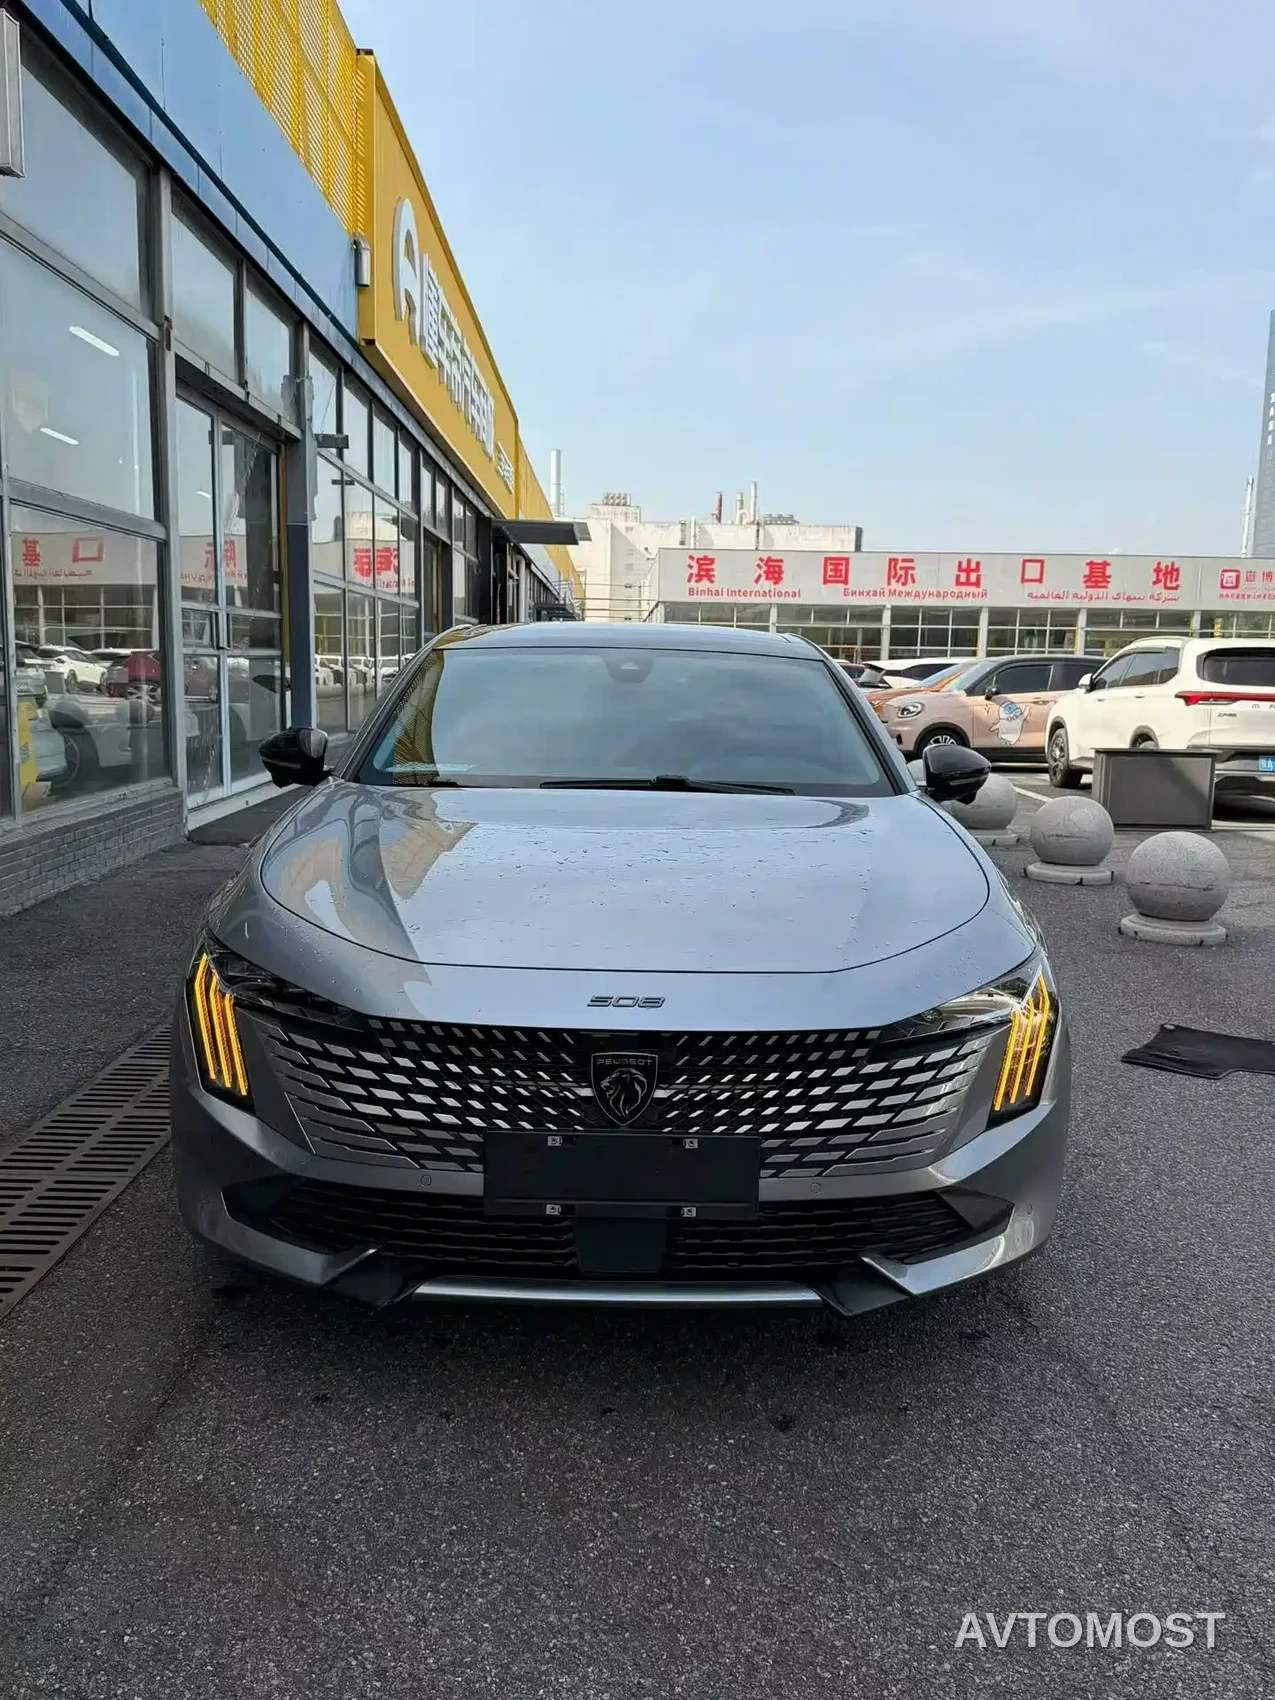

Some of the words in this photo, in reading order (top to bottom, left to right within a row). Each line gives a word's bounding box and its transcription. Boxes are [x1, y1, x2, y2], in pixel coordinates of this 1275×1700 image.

[687, 554, 1181, 591] 滨海国际出口基地
[688, 587, 724, 597] Binhai
[726, 588, 801, 598] International
[843, 587, 886, 598] Бинхай
[888, 588, 988, 600] Международный
[587, 996, 666, 1009] 508
[597, 1058, 653, 1066] PEUGEOT
